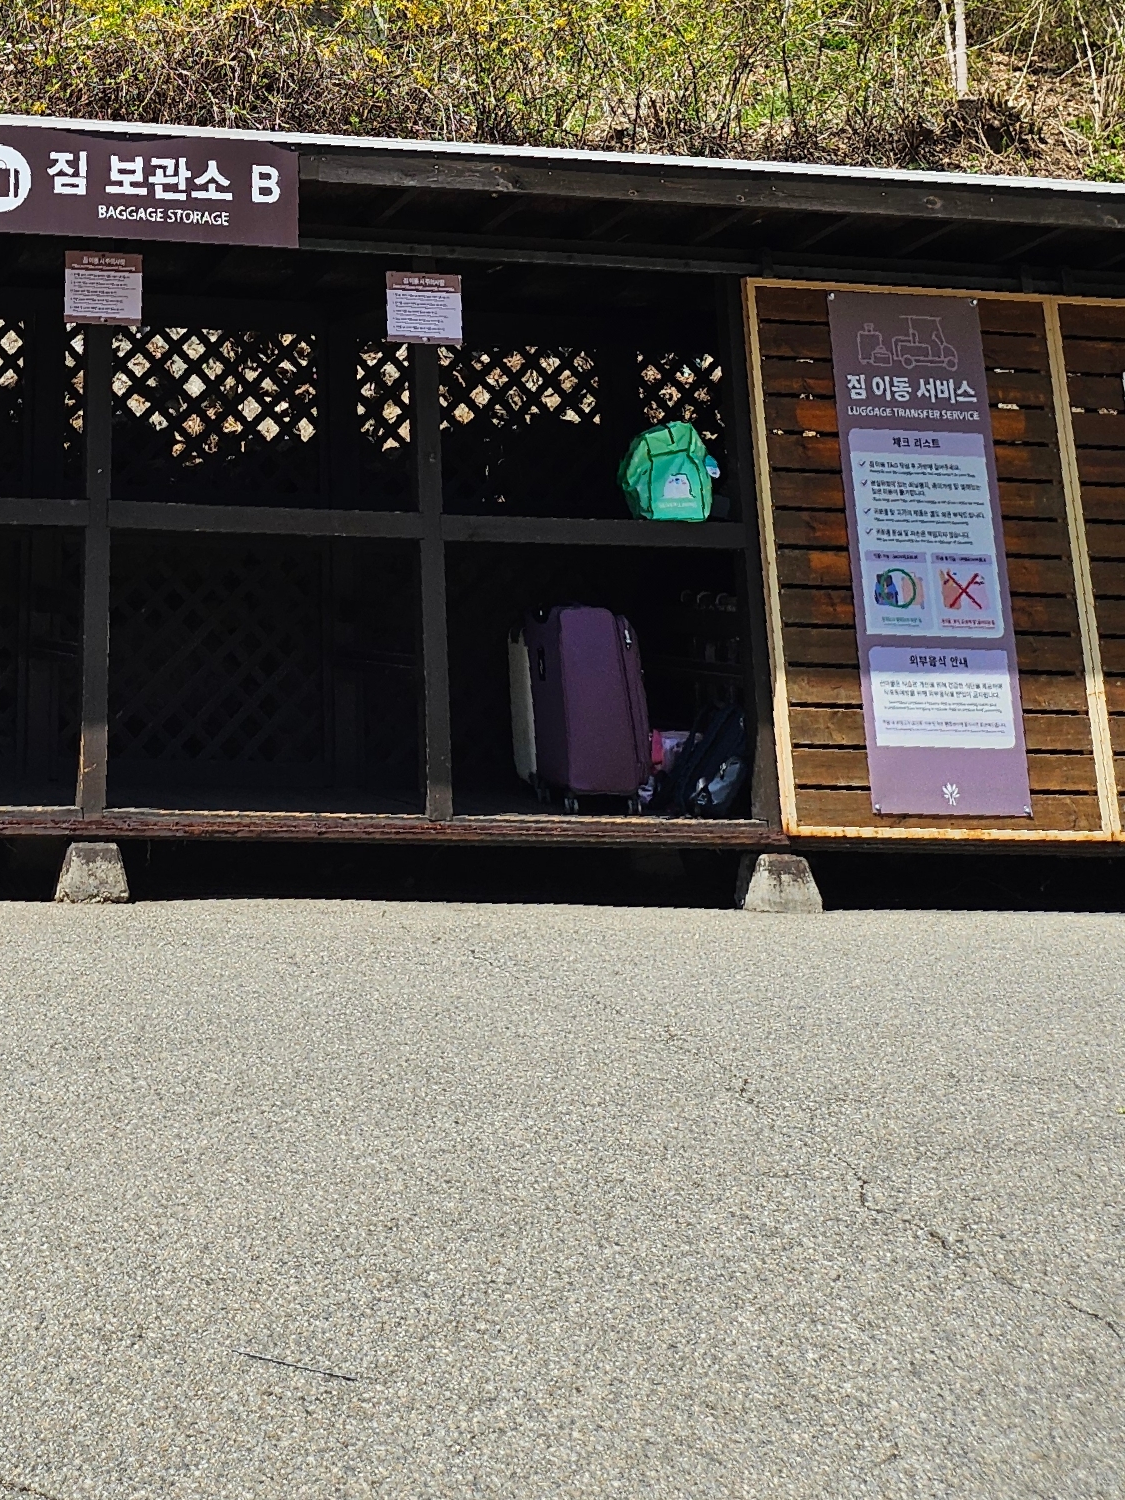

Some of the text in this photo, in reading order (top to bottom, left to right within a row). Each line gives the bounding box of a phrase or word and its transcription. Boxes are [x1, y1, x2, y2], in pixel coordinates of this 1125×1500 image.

[47, 151, 281, 203] 짐 보관소 B
[97, 205, 230, 226] BAGGAGE STORAGE
[847, 374, 977, 404] 짐 이동 서비스
[847, 406, 980, 421] LUGGAGE TRANSFER SERVICE
[892, 436, 941, 449] 체크 리스트
[909, 654, 969, 669] 외부음식 안내
